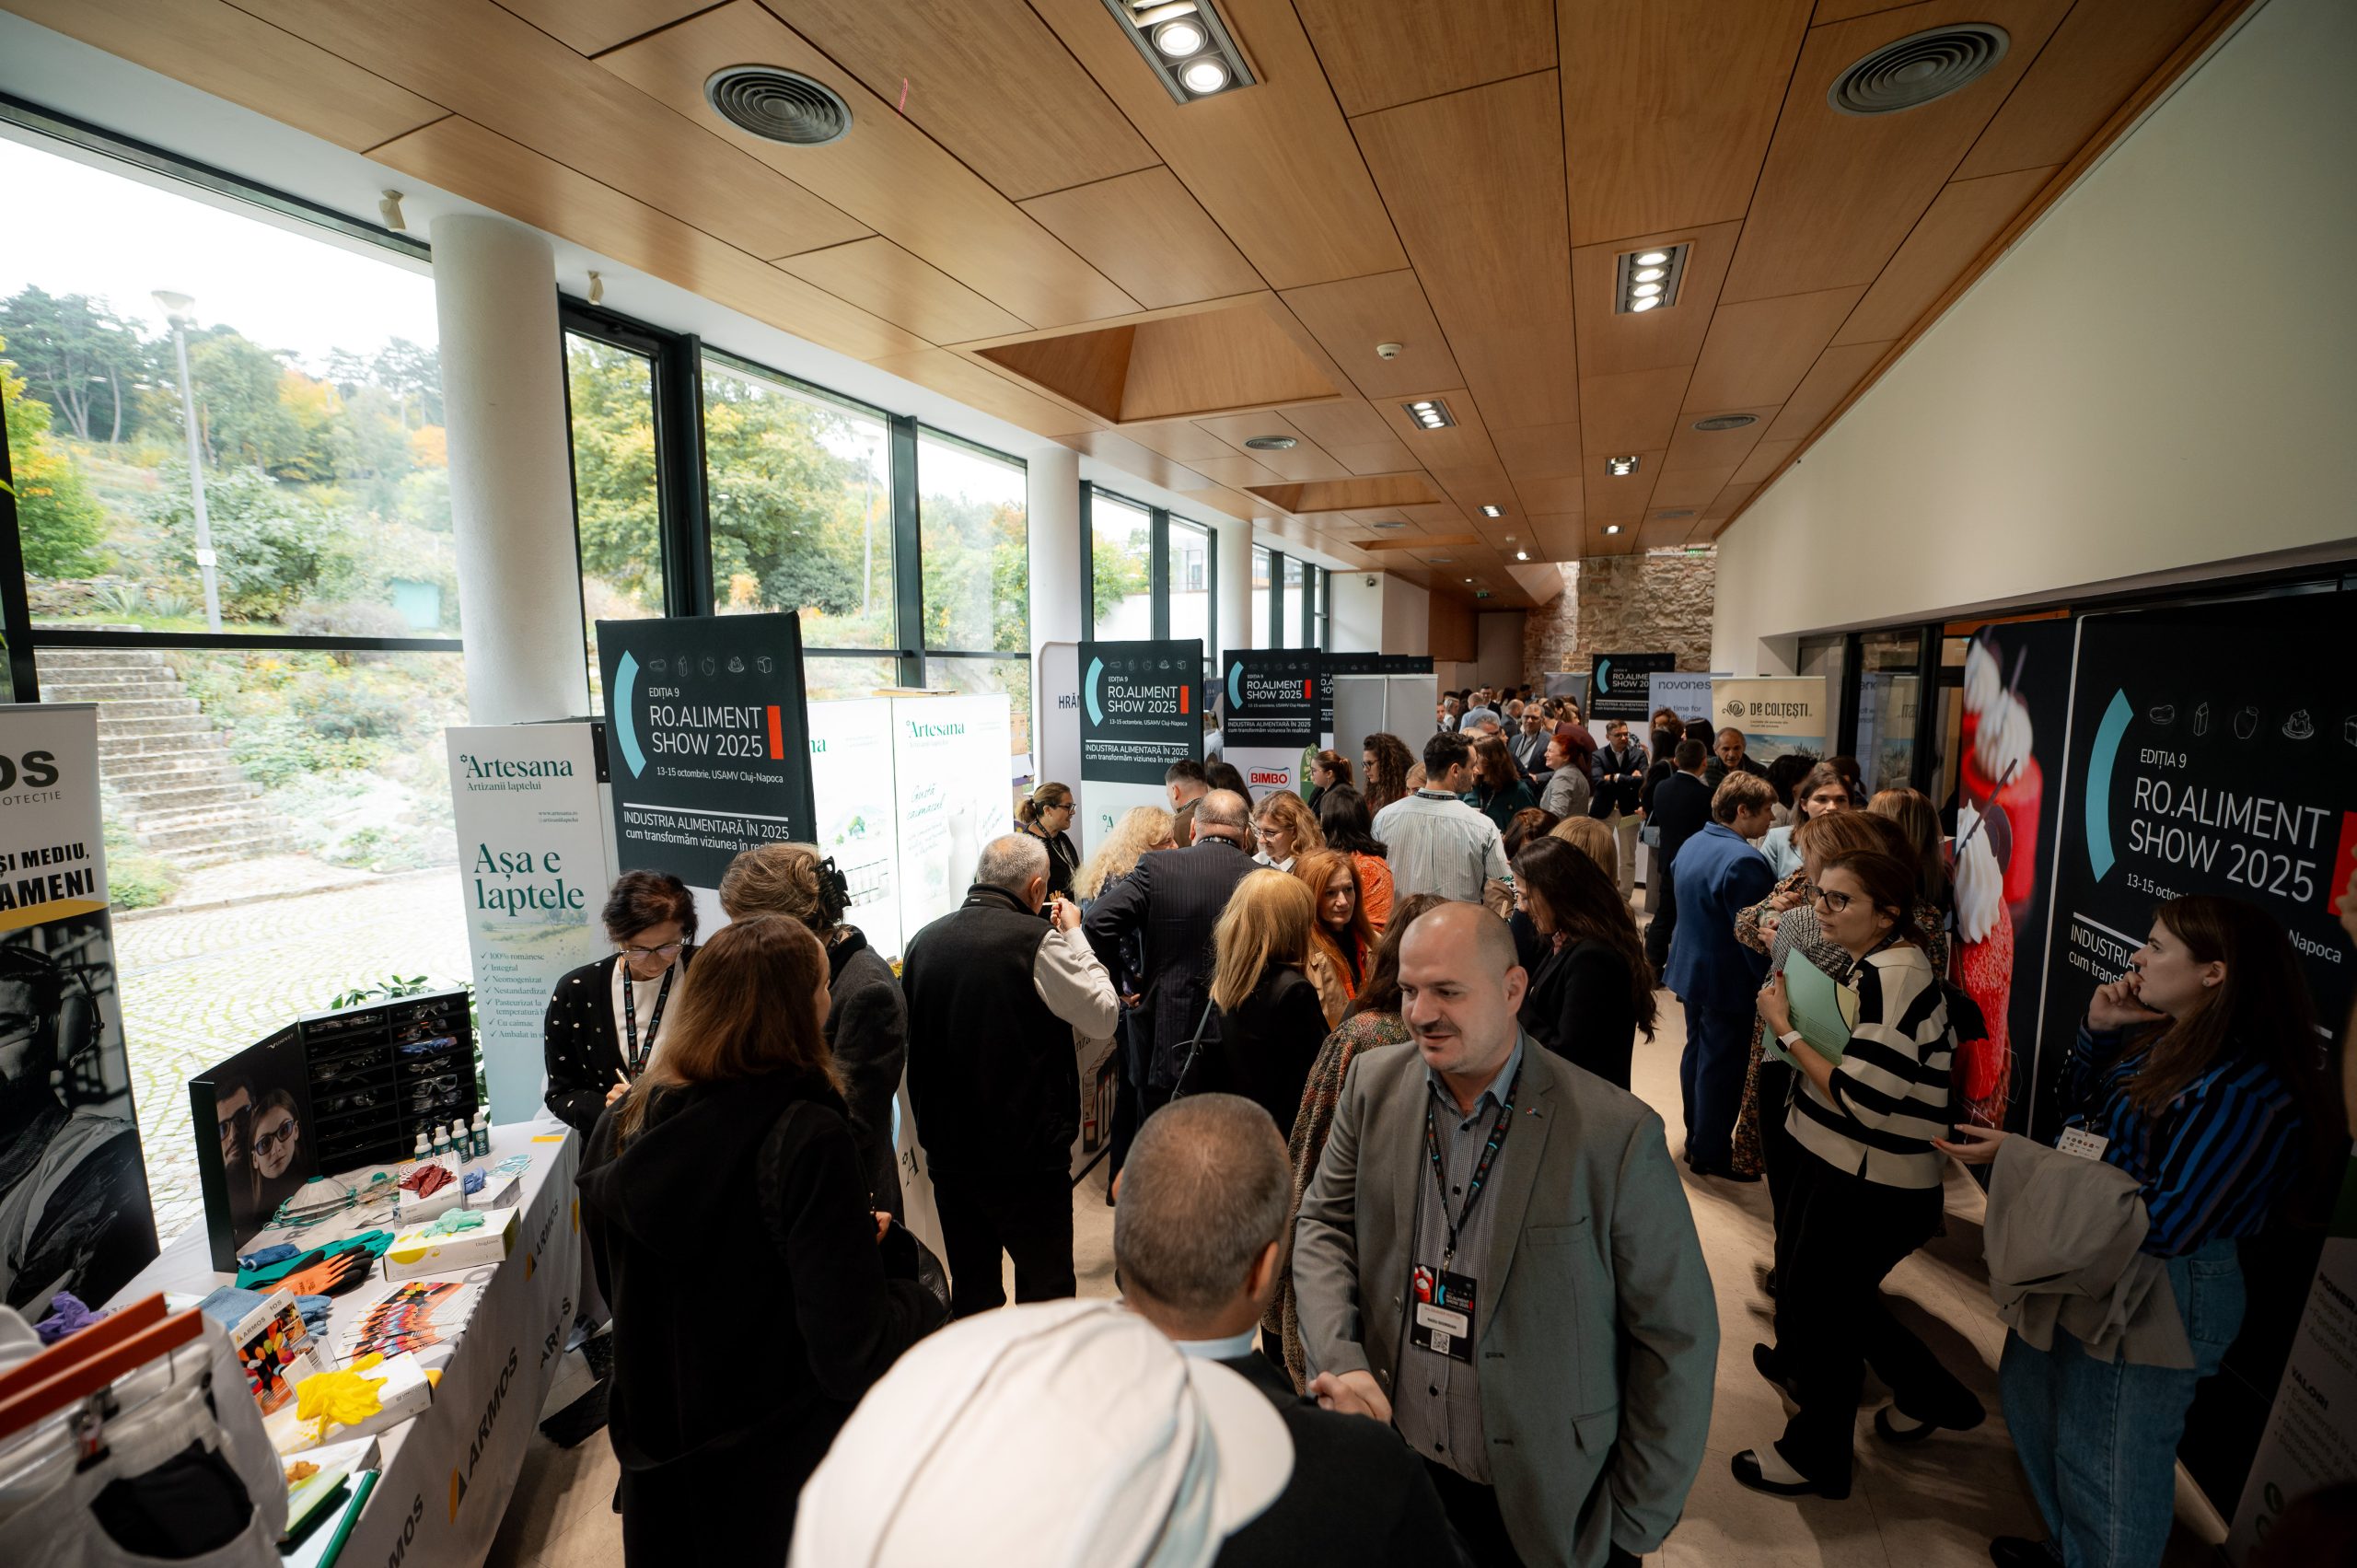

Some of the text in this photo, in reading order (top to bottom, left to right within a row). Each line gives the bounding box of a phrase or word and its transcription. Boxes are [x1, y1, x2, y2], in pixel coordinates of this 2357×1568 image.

[649, 688, 679, 700] EDIȚIA 9
[1109, 686, 1178, 699] RO.ALIMENT
[1247, 680, 1303, 689] RO.ALIMENT
[1247, 691, 1302, 700] SHOW 2025
[649, 705, 761, 729] RO.ALIMENT
[1109, 701, 1177, 714] SHOW 2025
[909, 720, 965, 738] Artesana
[652, 732, 763, 757] SHOW 2025
[1086, 744, 1189, 756] INDUSTRIA ALIMENTARĂ ÎN 2025
[466, 755, 574, 778] Artesana
[1097, 753, 1132, 762] transformăm
[1132, 755, 1156, 763] viziunea
[2140, 748, 2188, 769] EDIȚIA 9
[656, 766, 677, 777] 13-15
[712, 770, 738, 781] USAMV
[739, 772, 784, 784] Cluj-Napoca
[1250, 773, 1287, 784] BIMBO
[467, 782, 541, 792] Artizanii laptelui
[2134, 776, 2331, 850] RO.ALIMENT
[624, 811, 790, 840] INDUSTRIA ALIMENTARĂ ÎN 2025
[626, 829, 643, 840] cum
[644, 830, 698, 847] transformăm
[700, 836, 737, 851] viziunea
[21, 842, 90, 869] MEDIU,
[474, 843, 562, 882] Așa e
[2129, 819, 2316, 902] SHOW 2025
[2127, 873, 2154, 894] 13-15
[475, 878, 586, 917] laptele
[2072, 924, 2136, 970] INDUSTRIA
[2069, 949, 2089, 972] cum
[499, 1030, 528, 1039] Ambalat
[535, 1200, 559, 1258] ARMOS
[243, 1317, 266, 1338] ARMOS
[2291, 1365, 2329, 1411] VALORI
[468, 1346, 519, 1474] ARMOS
